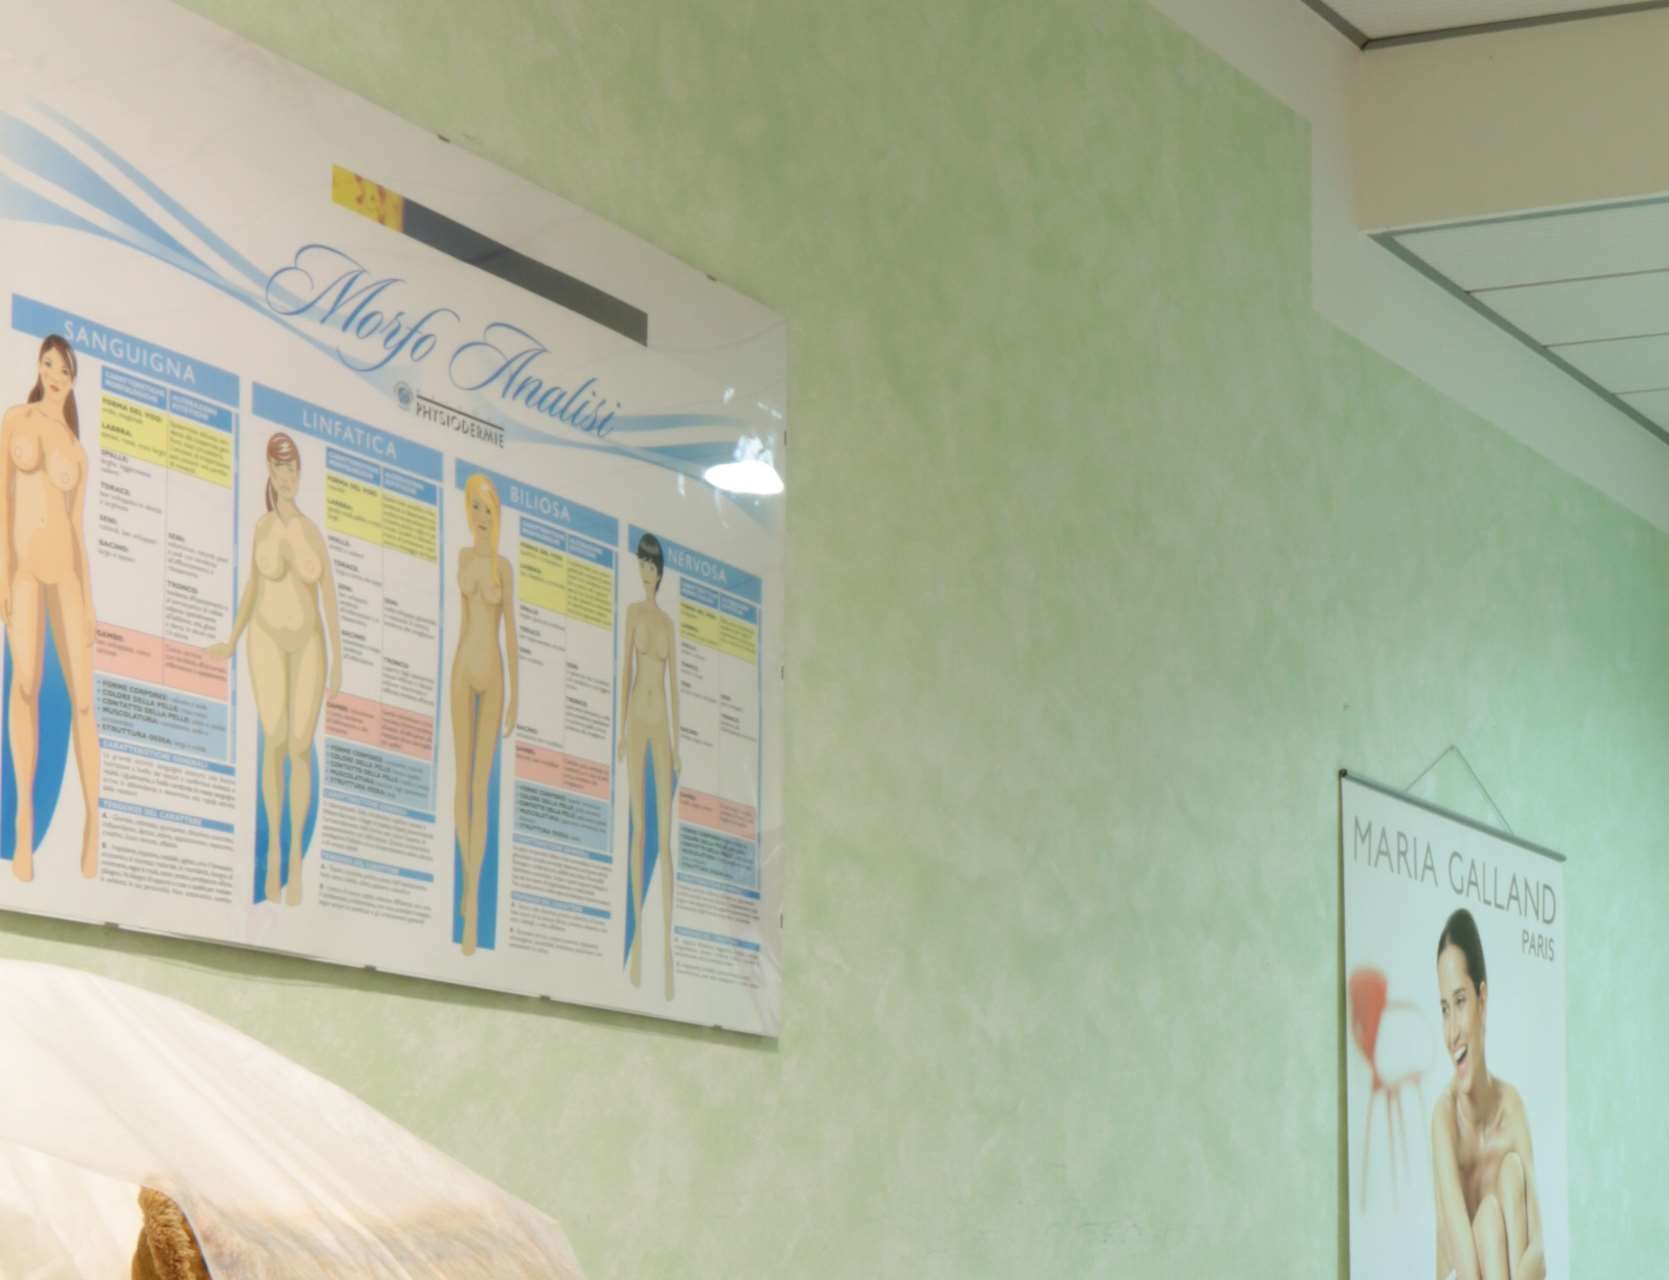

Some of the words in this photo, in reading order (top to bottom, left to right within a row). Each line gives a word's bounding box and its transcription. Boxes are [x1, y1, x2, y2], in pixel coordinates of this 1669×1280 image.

[63, 320, 196, 384] SANGUIGNA
[265, 243, 461, 373] Morfo
[448, 321, 622, 439] Analisi
[302, 408, 398, 460] LINFATICA
[416, 401, 505, 449] PHYSIODERMIE
[509, 485, 571, 524] BILIOSA
[667, 545, 728, 585] NERVOSA
[1352, 815, 1439, 888] MARIA
[1447, 850, 1558, 926] GALLAND
[1521, 928, 1555, 963] PARIS
